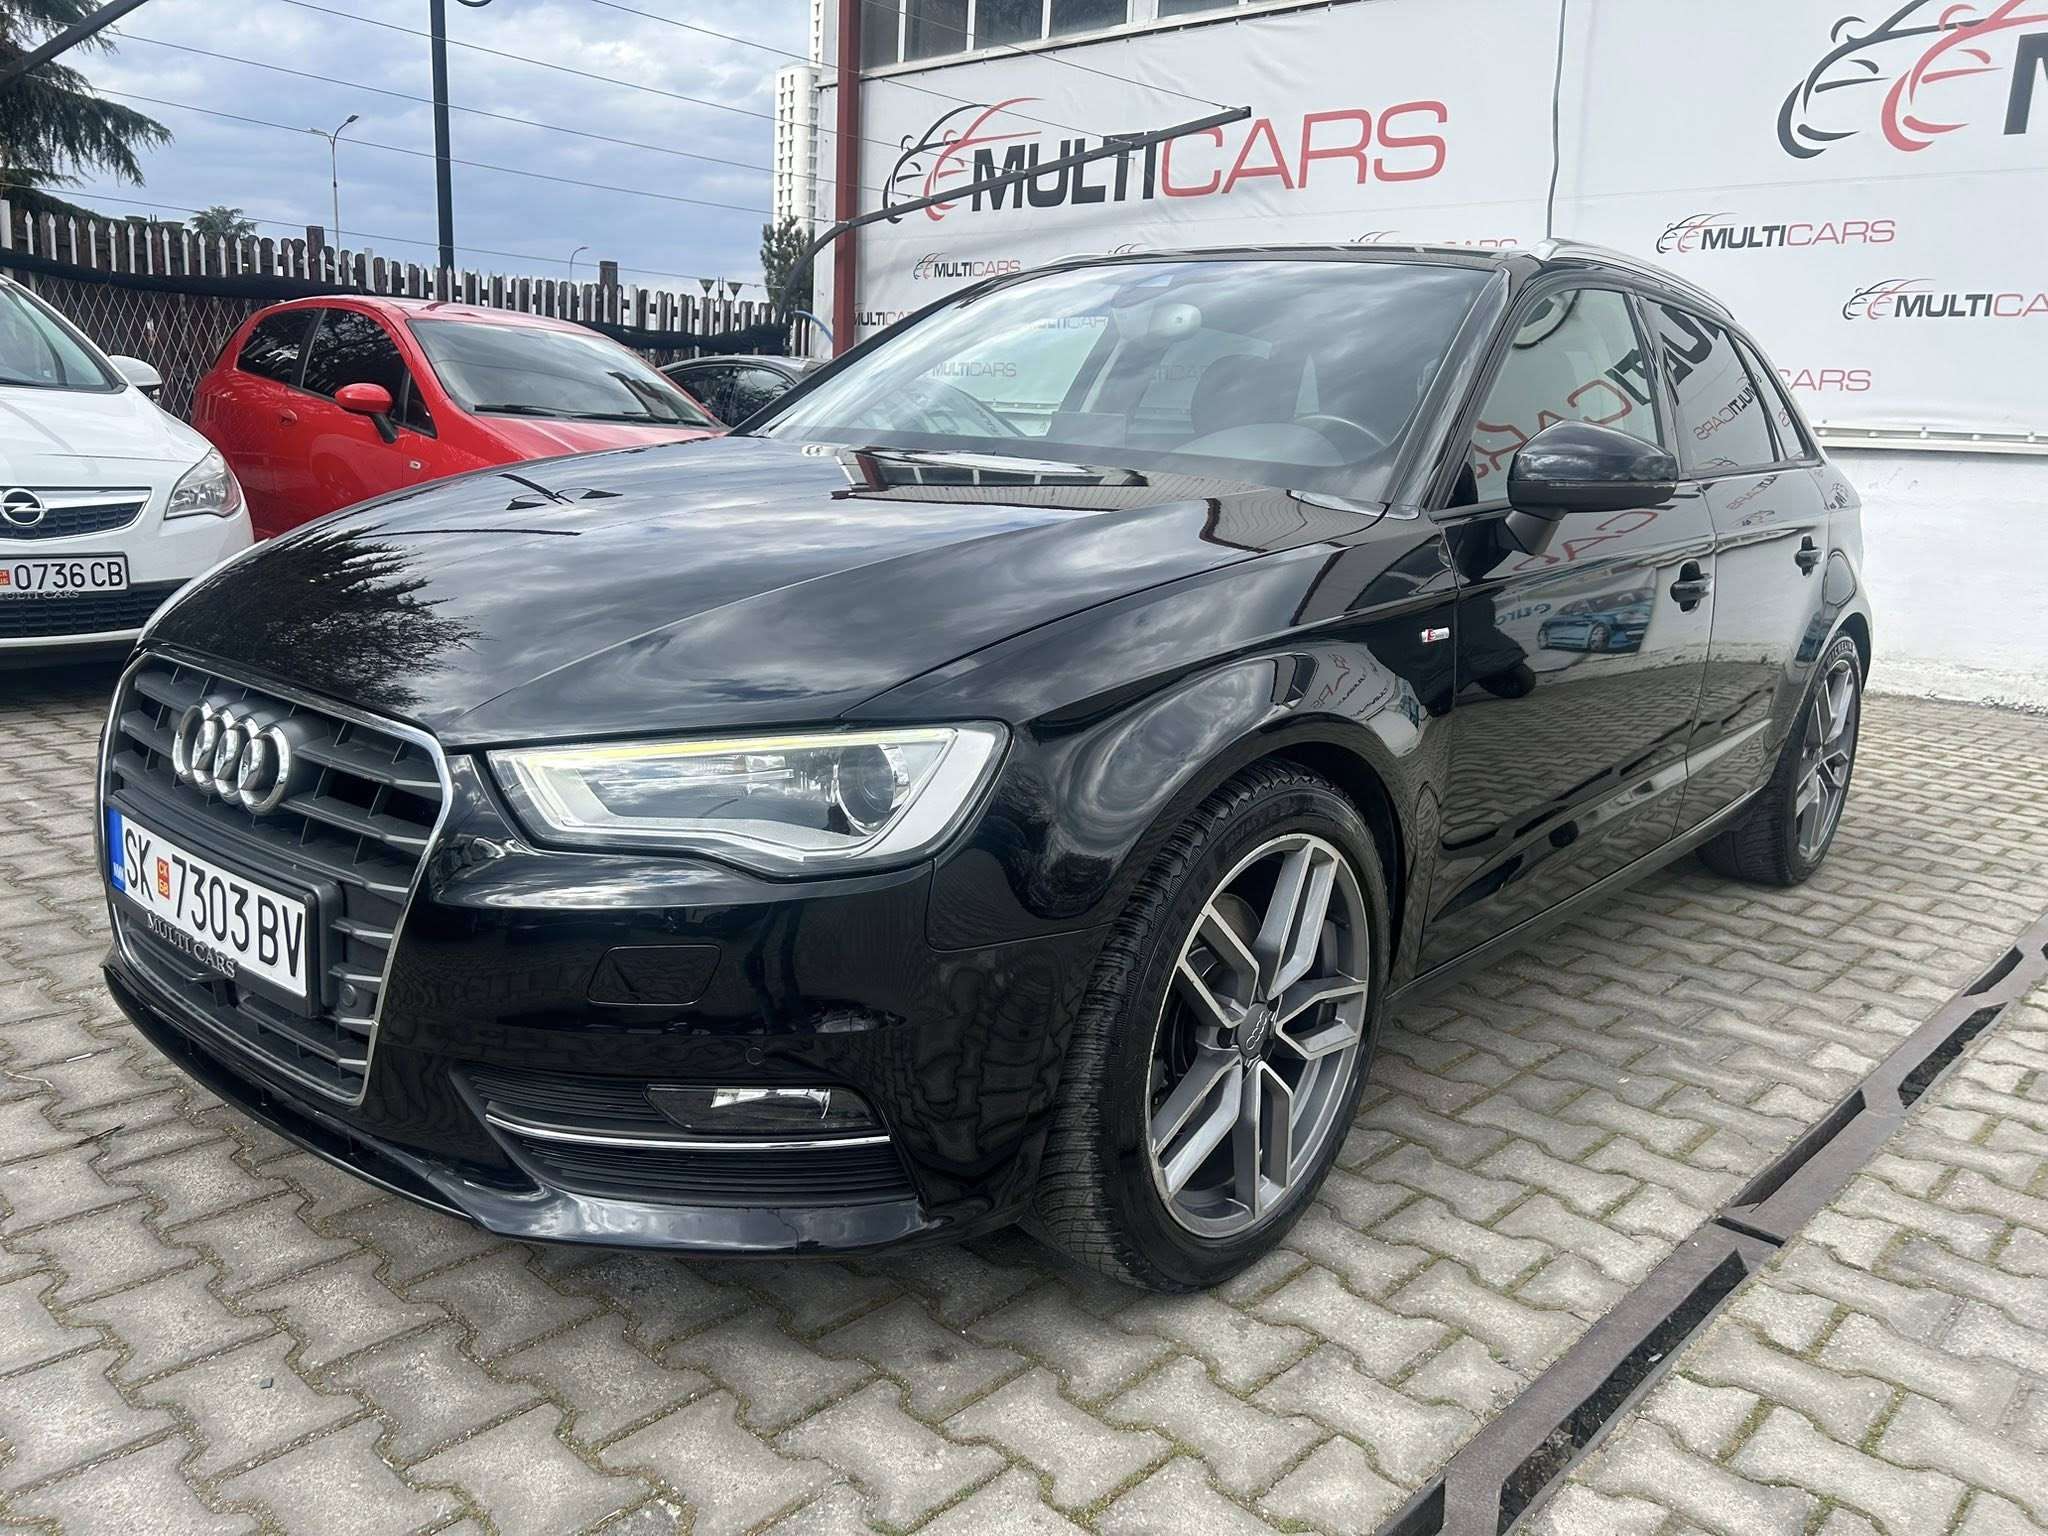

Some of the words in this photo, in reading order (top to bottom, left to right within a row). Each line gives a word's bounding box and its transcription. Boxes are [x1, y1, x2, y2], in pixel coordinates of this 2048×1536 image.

[971, 101, 1448, 212] MULTICARS
[1701, 220, 1896, 250] MULTICARS
[934, 260, 1021, 277] MULTICARS
[855, 311, 912, 326] MULTICA
[14, 563, 85, 590] 0736
[91, 562, 123, 587] CB
[125, 828, 154, 901] SK
[172, 853, 250, 952] 7303
[257, 894, 303, 977] BV
[147, 911, 193, 953] MULTI
[193, 942, 239, 978] CARS
